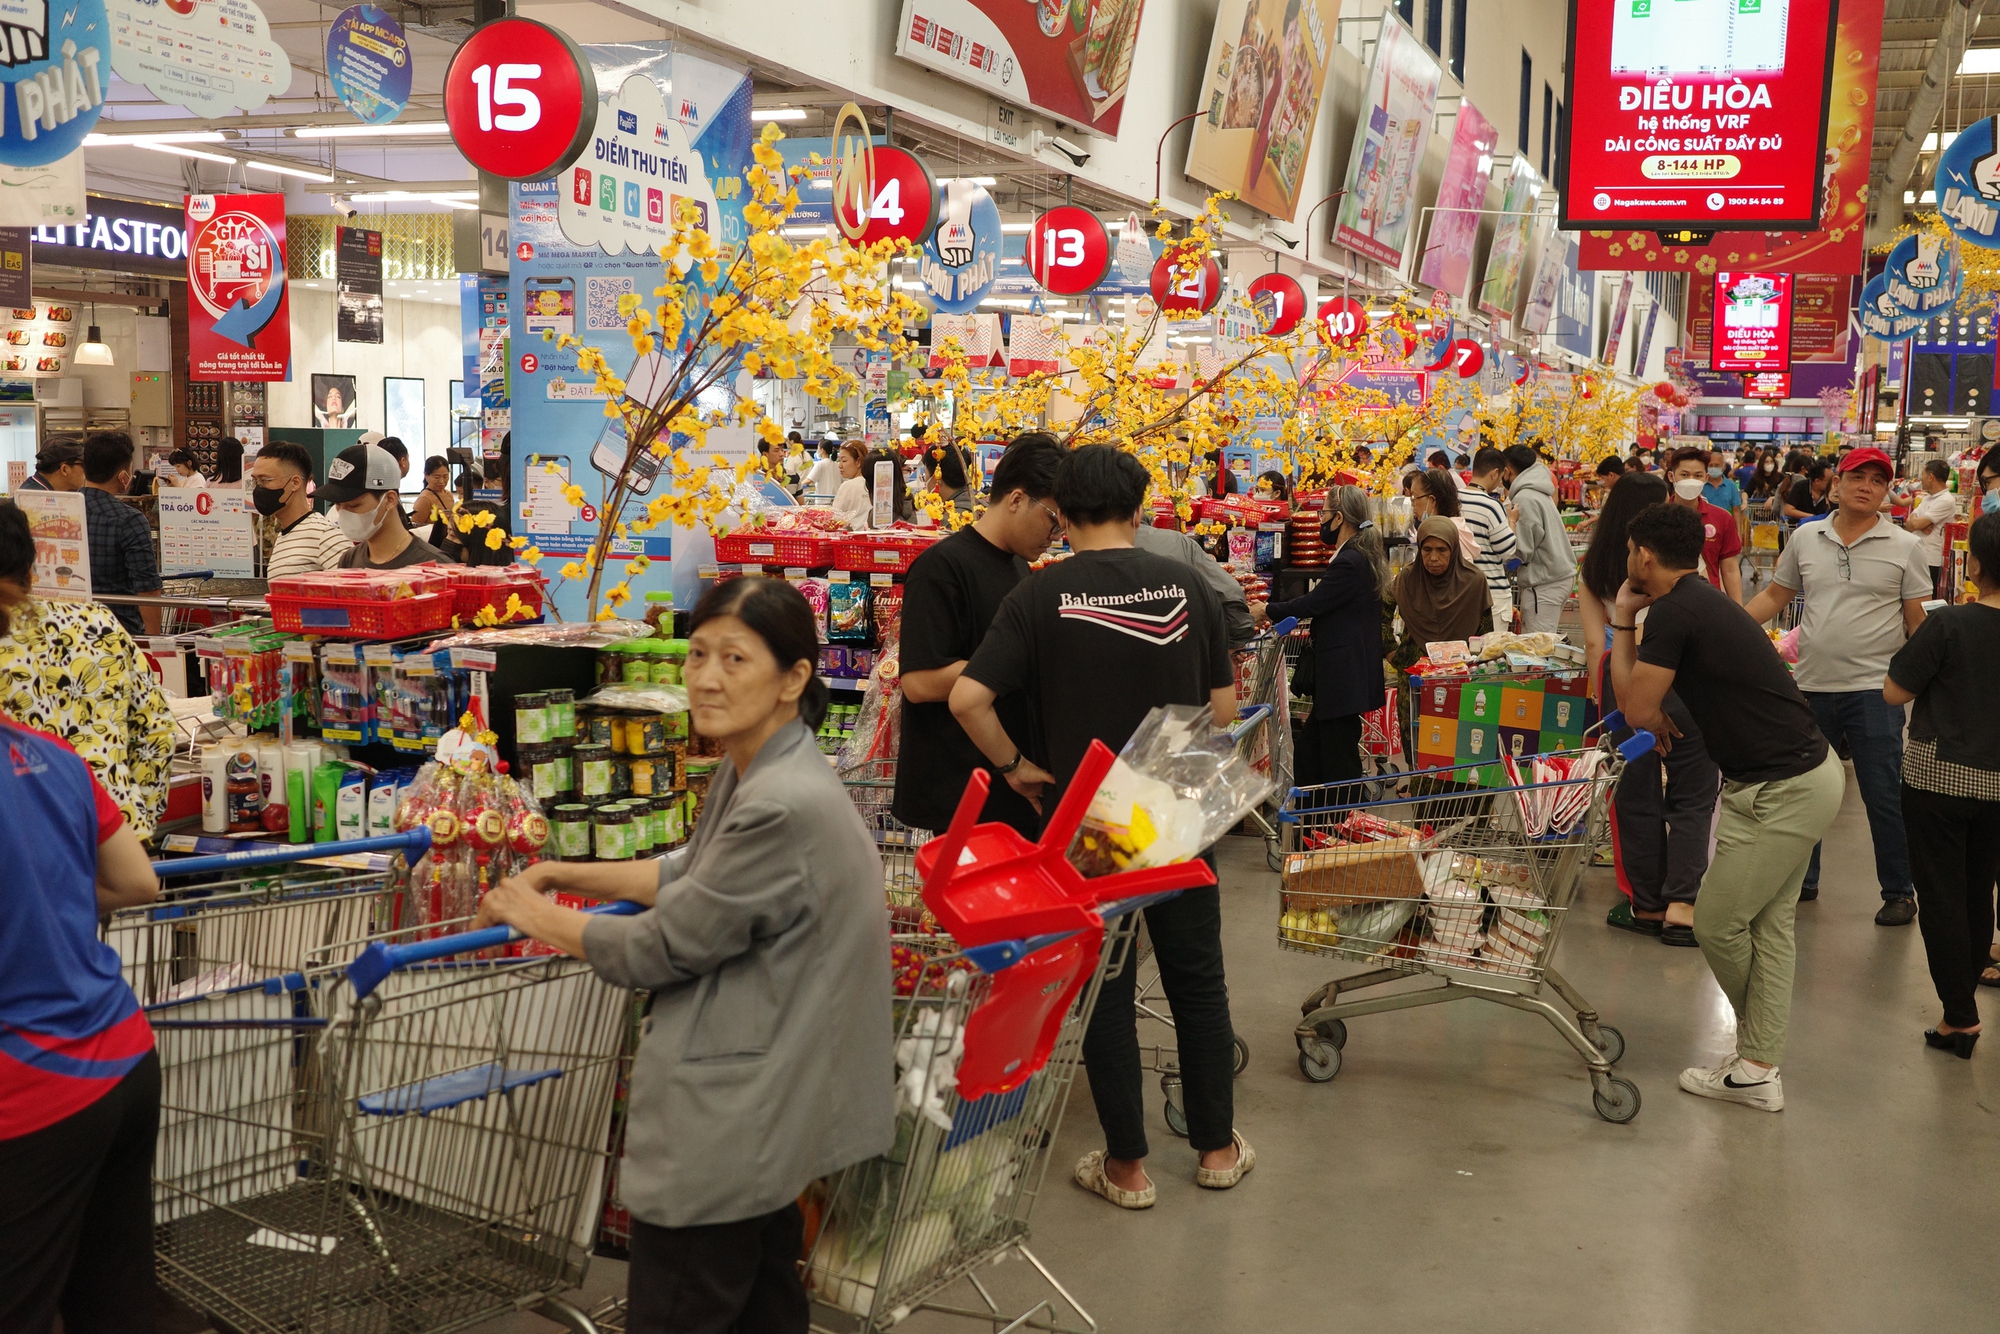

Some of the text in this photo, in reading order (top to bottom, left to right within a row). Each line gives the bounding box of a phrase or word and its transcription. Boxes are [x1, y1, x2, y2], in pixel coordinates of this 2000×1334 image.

[232, 22, 243, 30] VISA
[360, 22, 374, 33] APP
[15, 38, 102, 141] PHÁT
[471, 64, 542, 132] 15
[1619, 78, 1772, 110] ĐIỀU HÒA
[998, 106, 1014, 127] EXIT
[1638, 111, 1750, 134] hệ thống VRF
[1002, 133, 1017, 147] THOÁT
[1605, 133, 1782, 152] DẢI CÔNG SUẤT ĐẦY ĐỦ
[595, 135, 687, 184] ĐIỂM THU TIỀN
[1657, 159, 1725, 170] 8-144 HP
[521, 182, 552, 192] QUAN
[715, 177, 742, 201] APP
[543, 200, 557, 211] phí
[1614, 198, 1686, 207] Nagakawa.com.vn
[1941, 187, 1999, 236] LẠM
[520, 214, 534, 223] với
[578, 209, 586, 217] Điện
[216, 222, 249, 240] GIÁ
[623, 220, 631, 228] Điện
[658, 228, 666, 236] Hình
[75, 213, 187, 260] FASTFO
[482, 227, 508, 258] 14
[522, 245, 529, 258] 1
[1044, 228, 1085, 266] 13
[920, 251, 996, 301] LẠM PHÁT
[1168, 264, 1203, 298] 12
[1888, 278, 1919, 310] LẠM
[1326, 311, 1356, 337] 10
[1864, 311, 1890, 335] LẠM
[1728, 327, 1775, 339] ĐIỀU HÒA
[199, 362, 217, 370] nông
[238, 362, 249, 370] trại
[524, 357, 535, 370] 2
[1458, 348, 1471, 366] 7
[570, 386, 587, 397] ĐẶT
[161, 502, 194, 512] TRẢ GÓP
[584, 507, 594, 518] 3
[614, 541, 642, 551] ZaloPay
[1060, 584, 1186, 607] Balenmechoida
